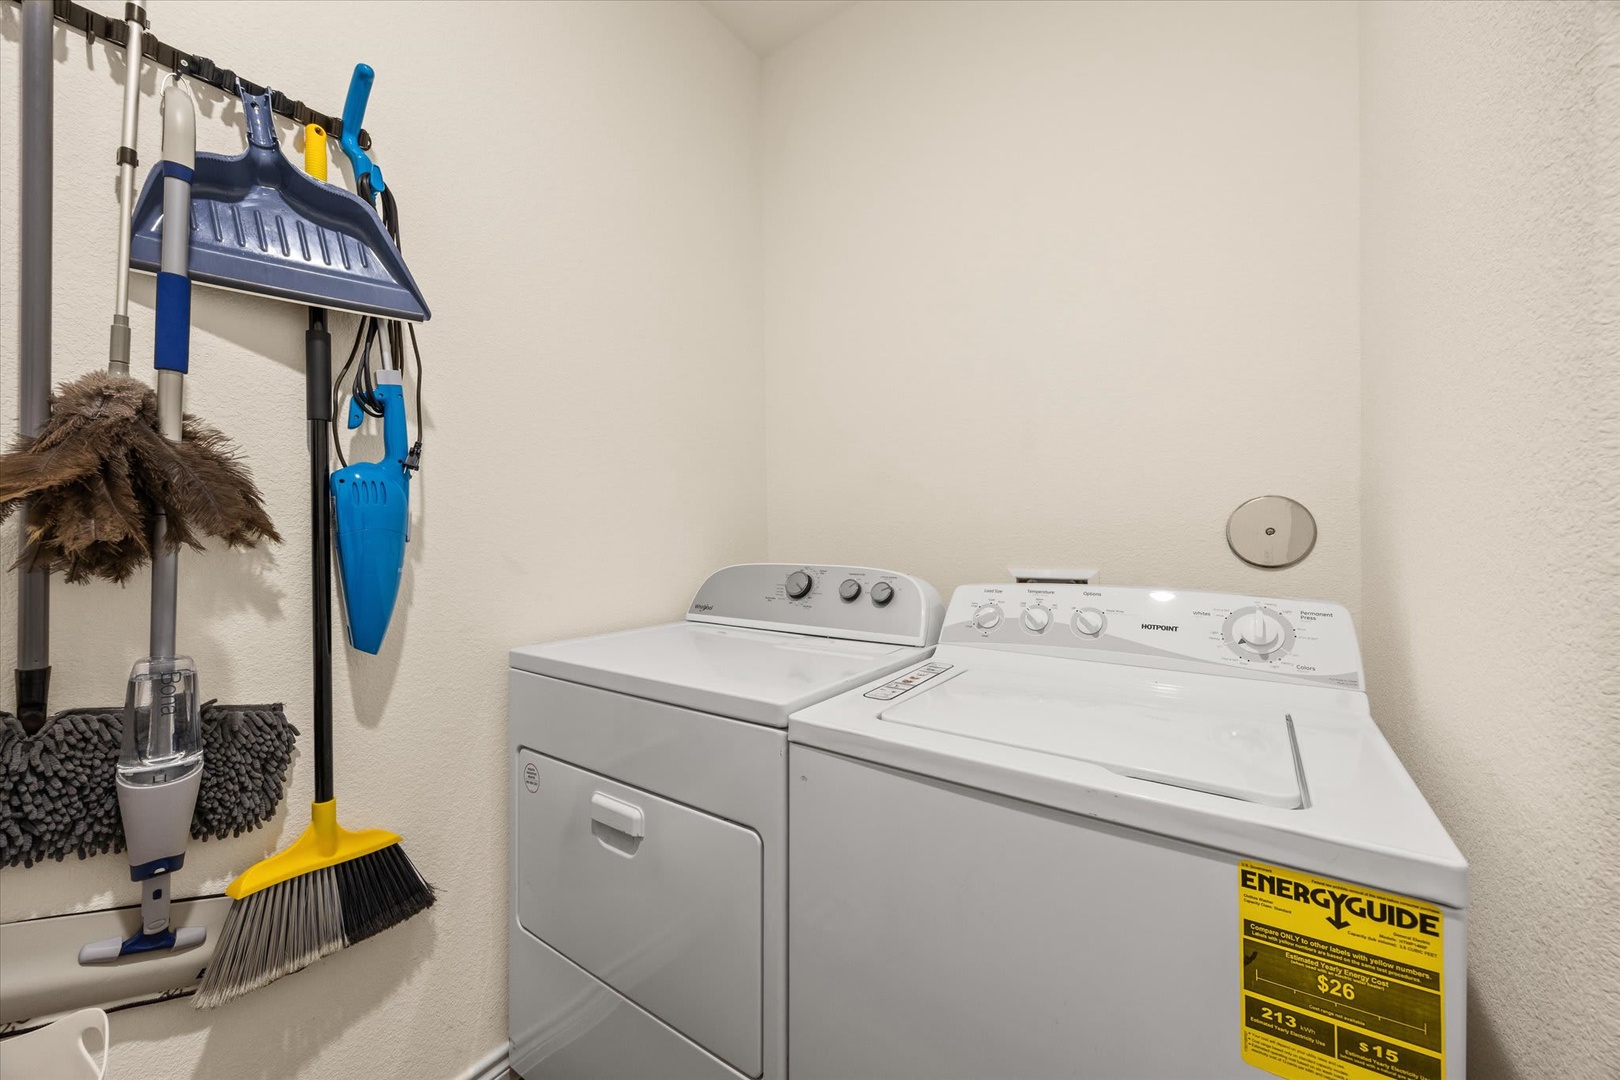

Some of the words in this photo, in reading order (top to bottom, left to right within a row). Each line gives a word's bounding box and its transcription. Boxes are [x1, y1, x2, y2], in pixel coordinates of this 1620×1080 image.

[1027, 588, 1055, 596] Temperature
[1300, 610, 1334, 618] Permanent
[1141, 623, 1179, 632] HOTPOINT
[1296, 664, 1316, 672] Colors
[161, 671, 181, 716] Bona
[1250, 864, 1272, 873] Government
[1241, 868, 1440, 938] ENERGYGUIDE
[1243, 893, 1259, 901] Clothes
[1259, 896, 1274, 905] Washer
[1244, 898, 1260, 906] Capacity
[1274, 906, 1292, 915] Standard
[1347, 930, 1367, 940] Capacity
[1408, 946, 1423, 955] CUBIC
[1424, 950, 1438, 958] FEET
[1393, 931, 1412, 941] General
[1412, 937, 1431, 946] Electric
[1250, 923, 1280, 937] Compare
[1280, 931, 1300, 942] ONLY
[1309, 941, 1329, 951] other
[1329, 945, 1351, 957] labels
[1352, 952, 1368, 962] with
[1369, 955, 1395, 969] yellow
[1395, 964, 1433, 981] numbers.
[1251, 930, 1267, 939] Labels
[1268, 934, 1278, 942] with
[1278, 939, 1295, 947] yellow
[1295, 943, 1317, 954] numbers
[1326, 952, 1343, 961] based
[1351, 958, 1360, 966] the
[1361, 962, 1376, 971] same
[1376, 966, 1388, 974] test
[1285, 951, 1319, 967] Estimated
[1320, 962, 1343, 975] Yearly
[1343, 969, 1370, 983] Energy
[1371, 977, 1390, 988] Cost
[1317, 974, 1355, 1001] $26
[1261, 1007, 1297, 1028] 213
[1300, 1025, 1316, 1035] kWh
[1321, 1008, 1334, 1016] range
[1335, 1012, 1343, 1020] not
[1343, 1016, 1366, 1026] available
[1250, 1016, 1274, 1029] Estimated
[1274, 1025, 1290, 1036] Yearly
[1290, 1030, 1315, 1044] Electricity
[1315, 1039, 1326, 1047] Use
[1345, 1049, 1372, 1063] Estimated
[1372, 1059, 1390, 1070] Yearly
[1391, 1065, 1419, 1079] Electricity
[1359, 1042, 1369, 1053] $
[1372, 1045, 1399, 1063] 15
